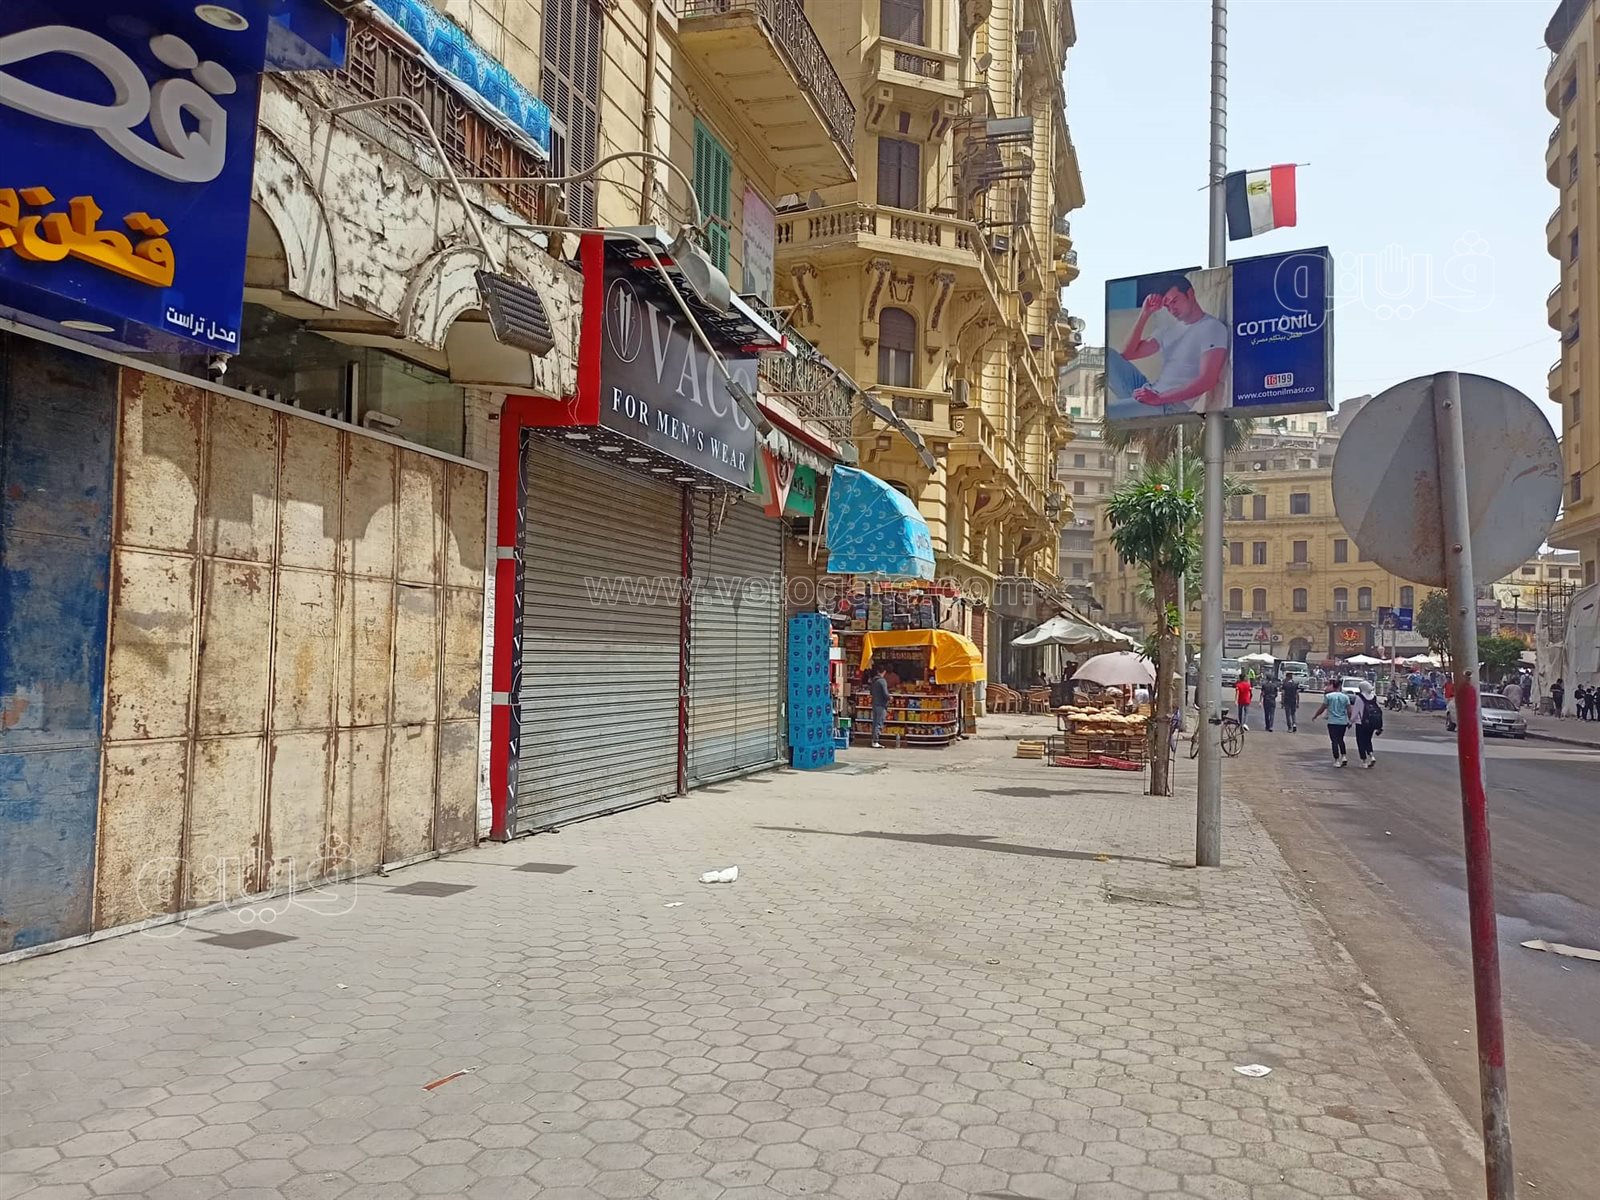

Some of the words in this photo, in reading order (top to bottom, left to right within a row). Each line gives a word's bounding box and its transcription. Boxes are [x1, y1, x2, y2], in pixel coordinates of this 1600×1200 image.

[166, 306, 205, 336] تراست
[207, 321, 236, 343] محل
[1237, 313, 1318, 336] COTTONIL
[645, 299, 751, 432] VACO
[1267, 373, 1292, 386] 16199
[1237, 386, 1315, 400] www.cottonilmasr.co
[612, 386, 650, 426] FOR
[656, 409, 705, 452] MEN'S
[710, 437, 746, 472] WEAR
